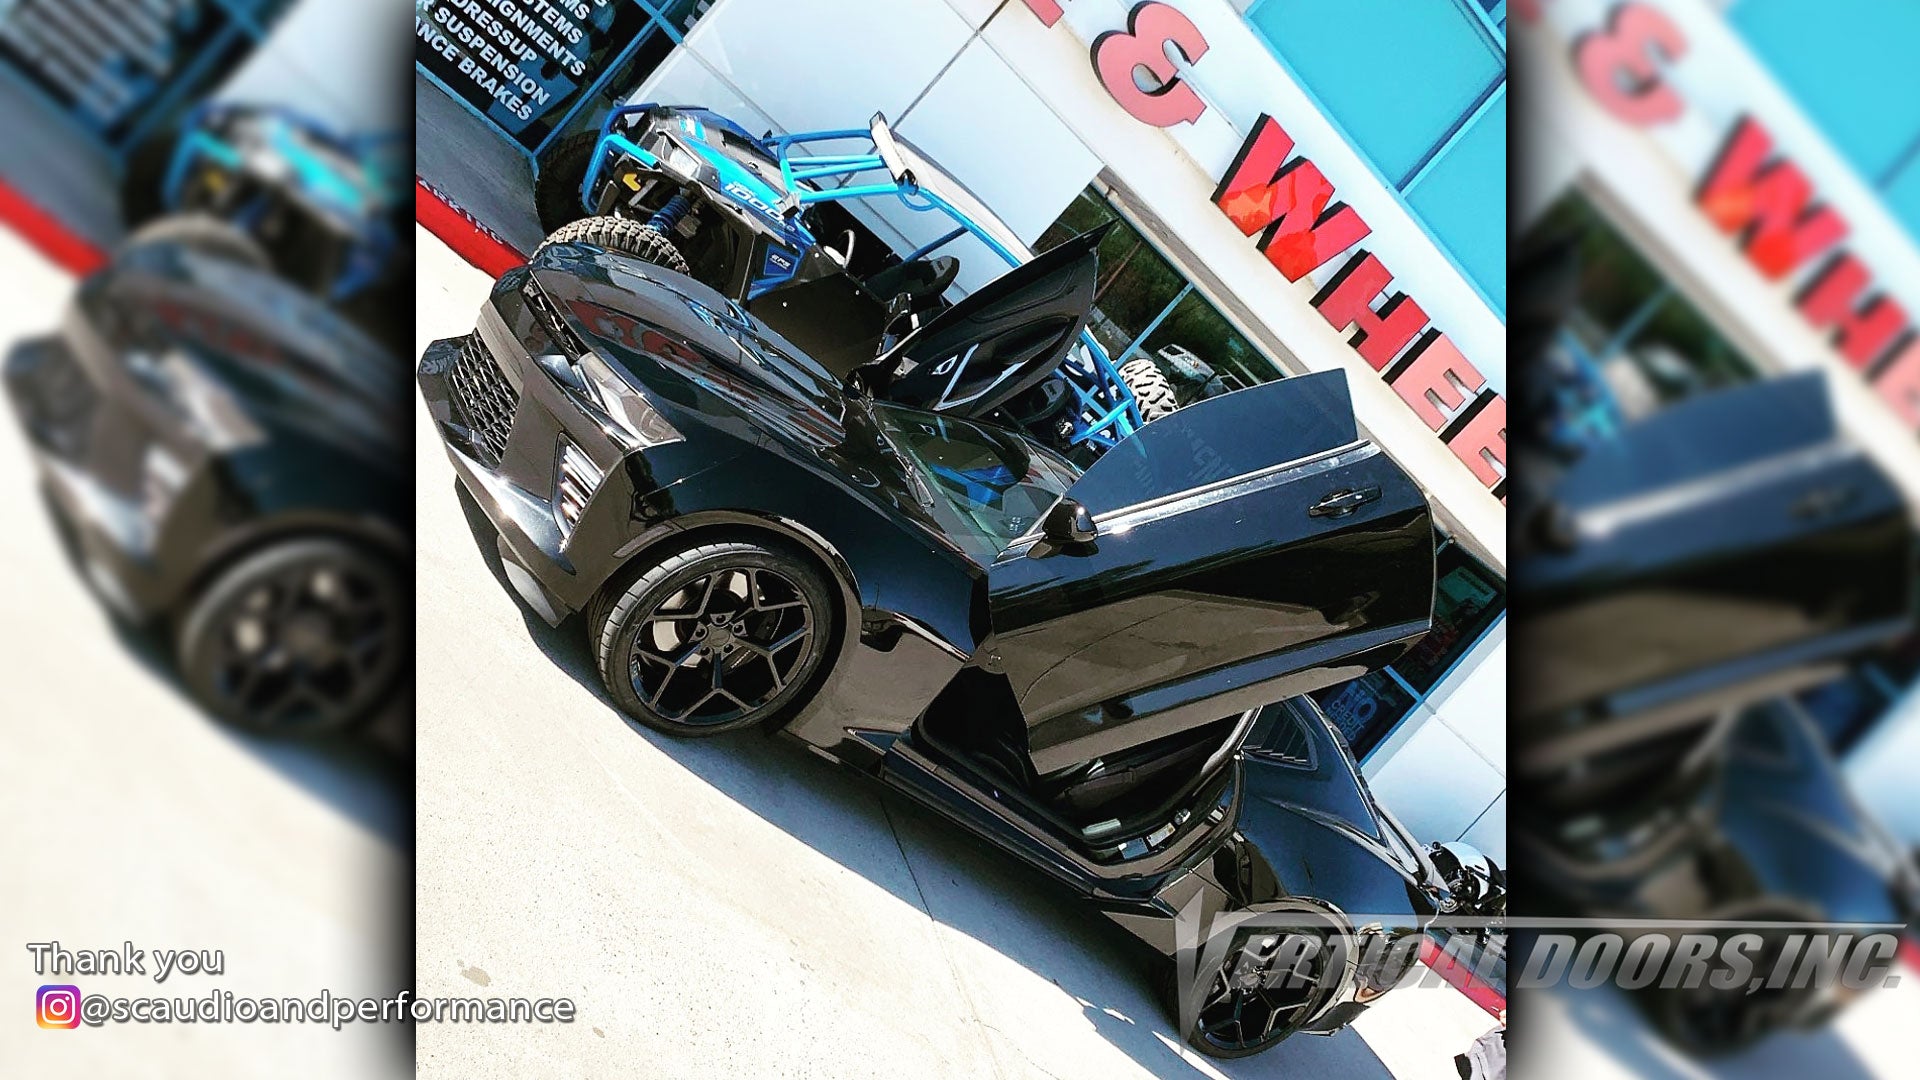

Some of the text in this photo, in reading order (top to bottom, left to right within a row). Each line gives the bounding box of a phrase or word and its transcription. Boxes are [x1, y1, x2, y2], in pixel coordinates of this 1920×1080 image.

[434, 6, 550, 106] SUSPENSION
[486, 0, 587, 77] IGNMENTS
[458, 56, 534, 121] BRAKES
[724, 182, 785, 221] 1000
[1210, 112, 1506, 507] WHEE
